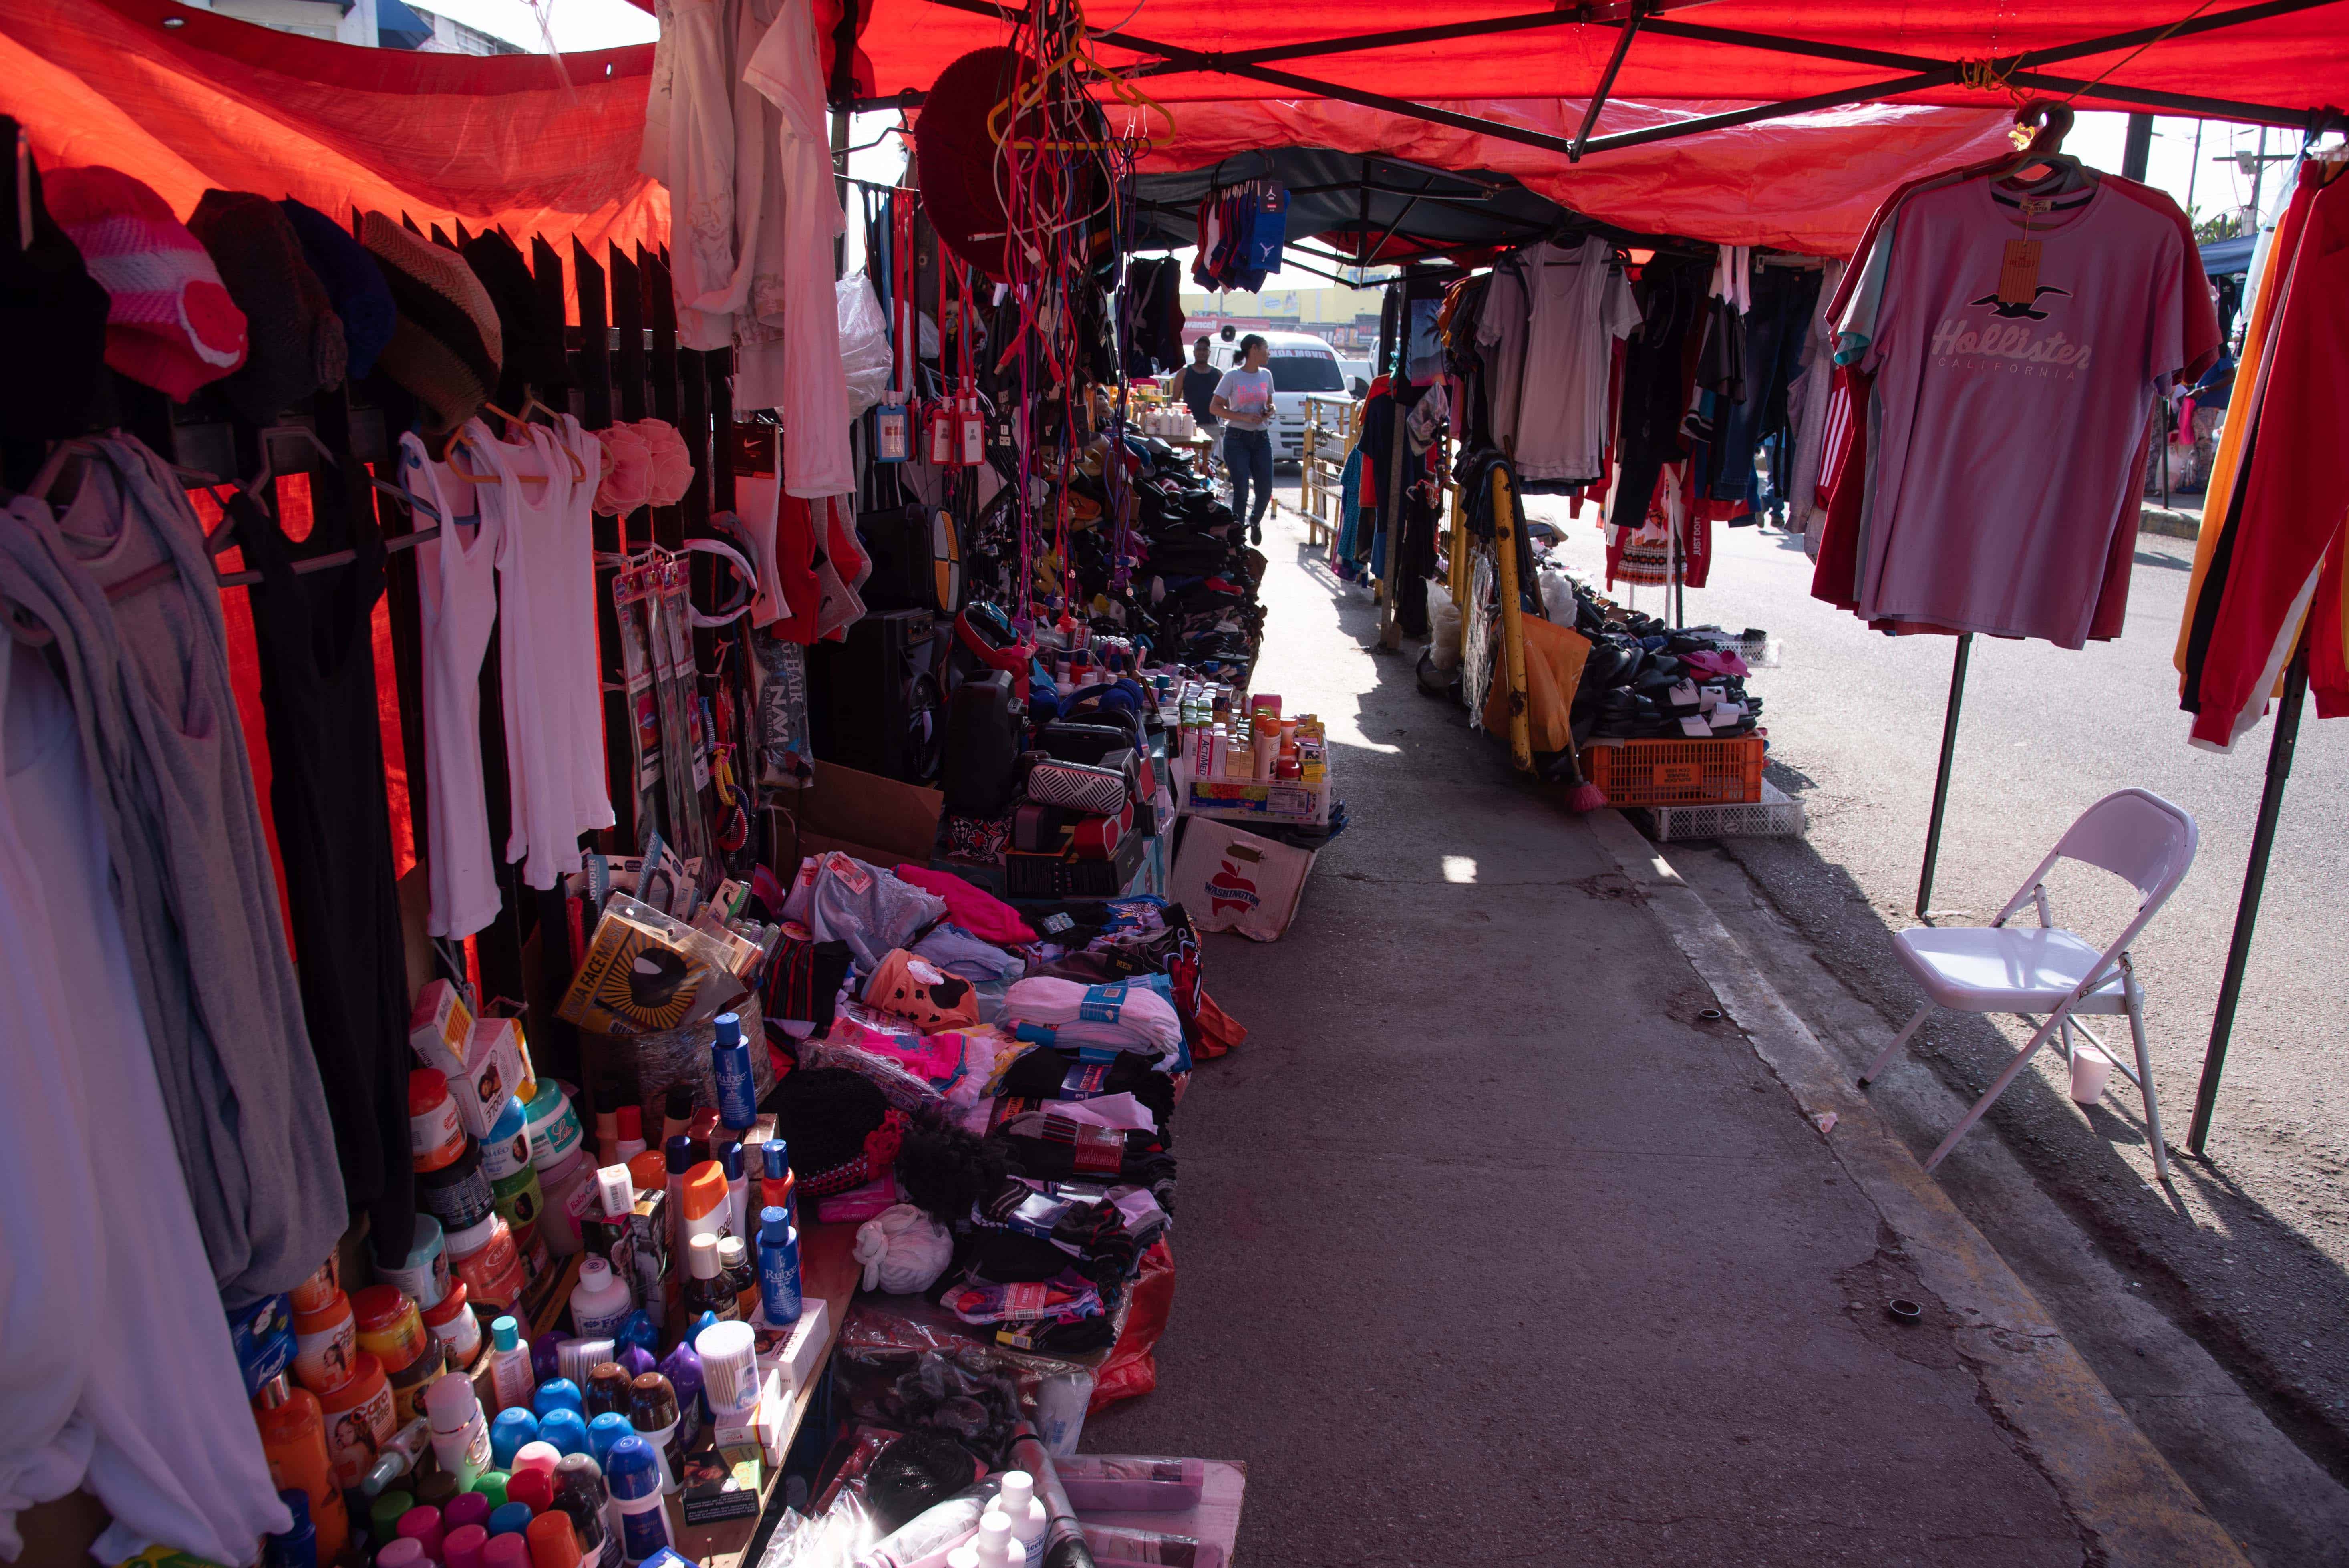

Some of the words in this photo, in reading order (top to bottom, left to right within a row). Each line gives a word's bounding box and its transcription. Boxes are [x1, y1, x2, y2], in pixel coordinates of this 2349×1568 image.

[1294, 350, 1328, 360] MOVIL
[1931, 319, 2092, 369] Hollister
[1938, 358, 2075, 381] CALIFORNIA
[1693, 536, 1701, 557] JUST
[784, 660, 803, 704] HAIR
[765, 686, 774, 744] COLLECTION
[769, 685, 789, 743] NAVI
[644, 833, 657, 872] POWDER
[1205, 882, 1260, 906] WASHINGTON
[1116, 958, 1133, 972] MEN
[716, 1071, 747, 1082] Rubee
[764, 1263, 798, 1279] Rubee
[443, 1336, 457, 1344] GHT
[776, 1332, 799, 1356] IDOLE
[350, 1390, 388, 1423] Caro
